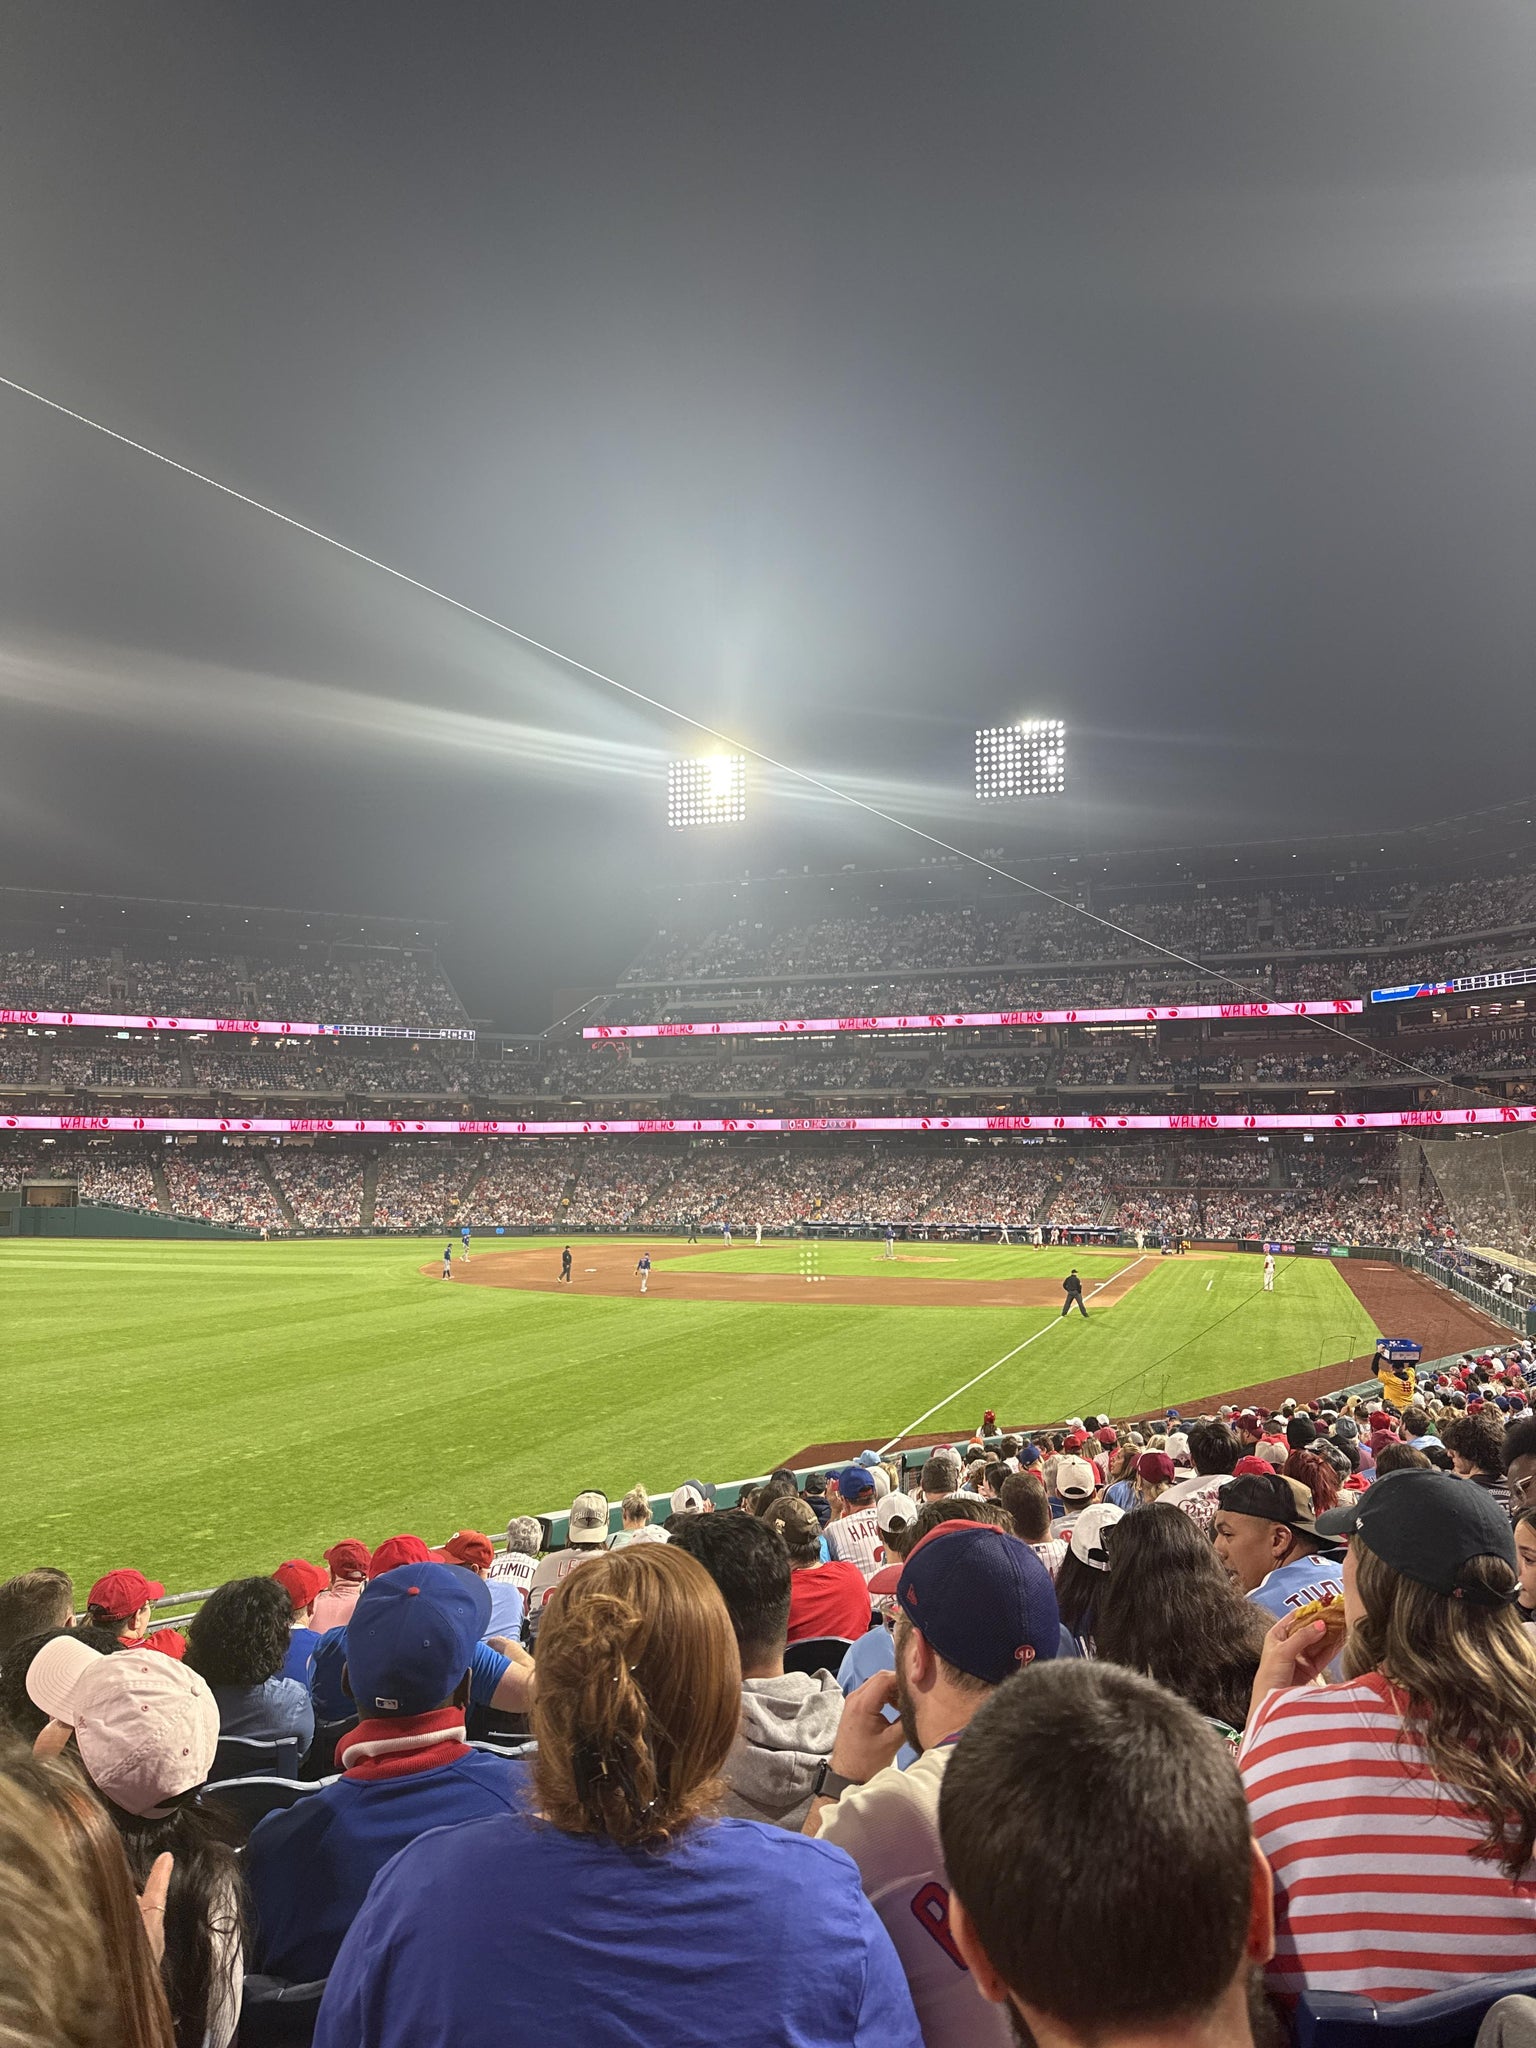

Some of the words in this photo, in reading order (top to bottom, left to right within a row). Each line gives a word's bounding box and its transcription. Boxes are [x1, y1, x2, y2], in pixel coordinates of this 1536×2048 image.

[1491, 1027, 1524, 1041] HOME
[847, 1520, 879, 1542] HAR
[487, 1562, 536, 1579] CHMIDT
